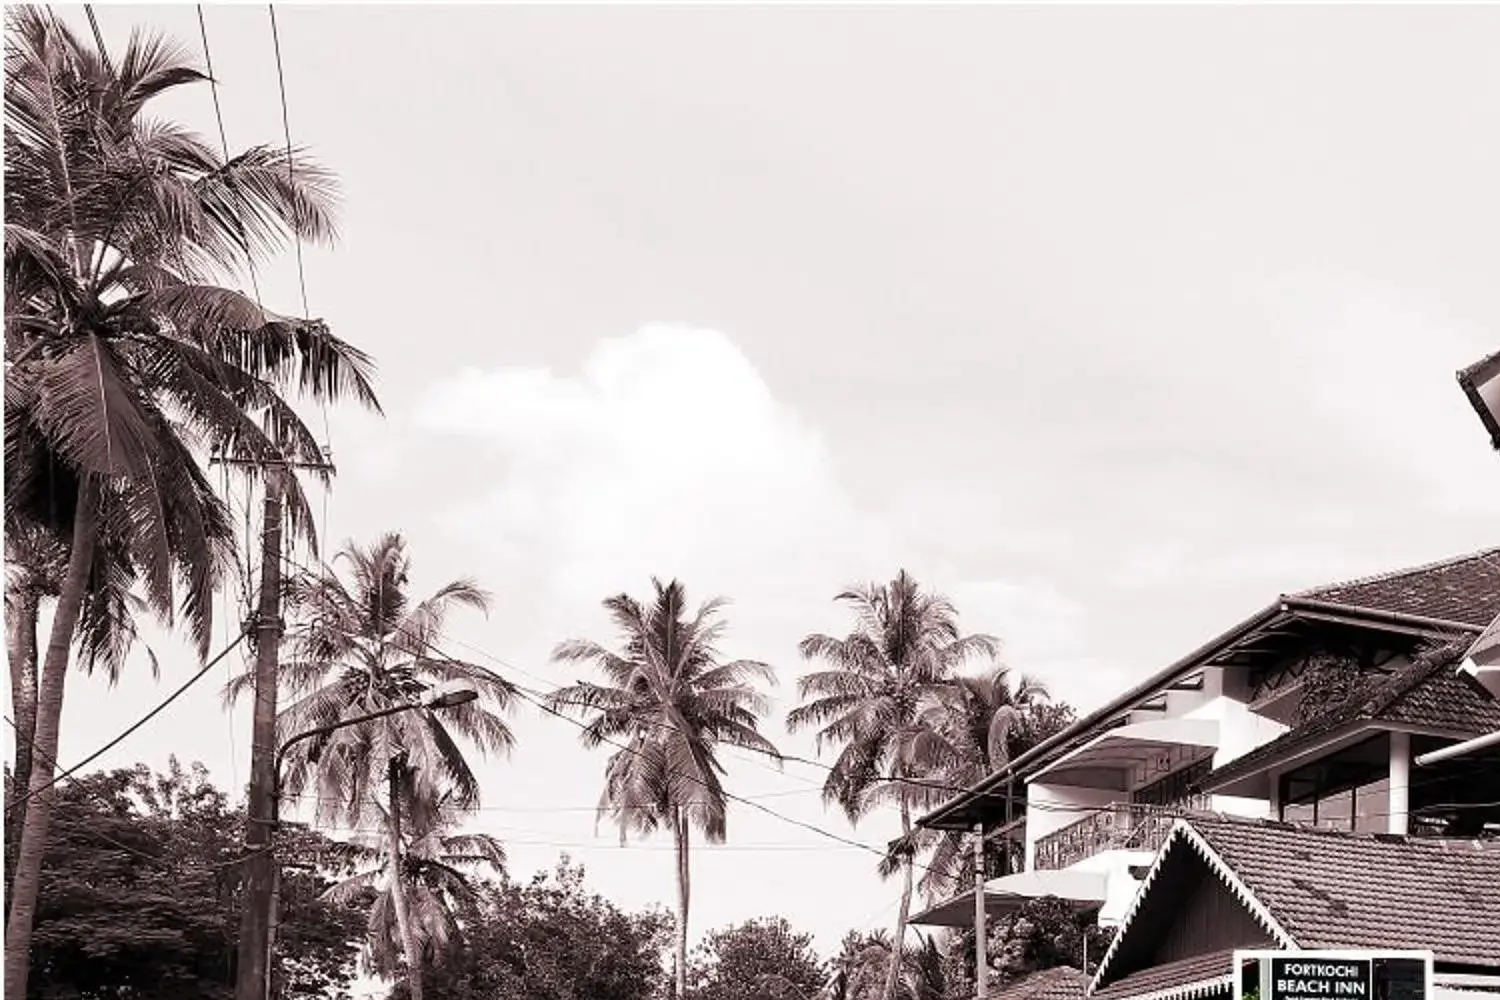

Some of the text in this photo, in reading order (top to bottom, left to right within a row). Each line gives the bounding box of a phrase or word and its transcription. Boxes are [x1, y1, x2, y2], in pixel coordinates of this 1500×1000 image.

[1284, 963, 1359, 977] FORTKOCHI
[1277, 980, 1365, 995] BEACH INN
